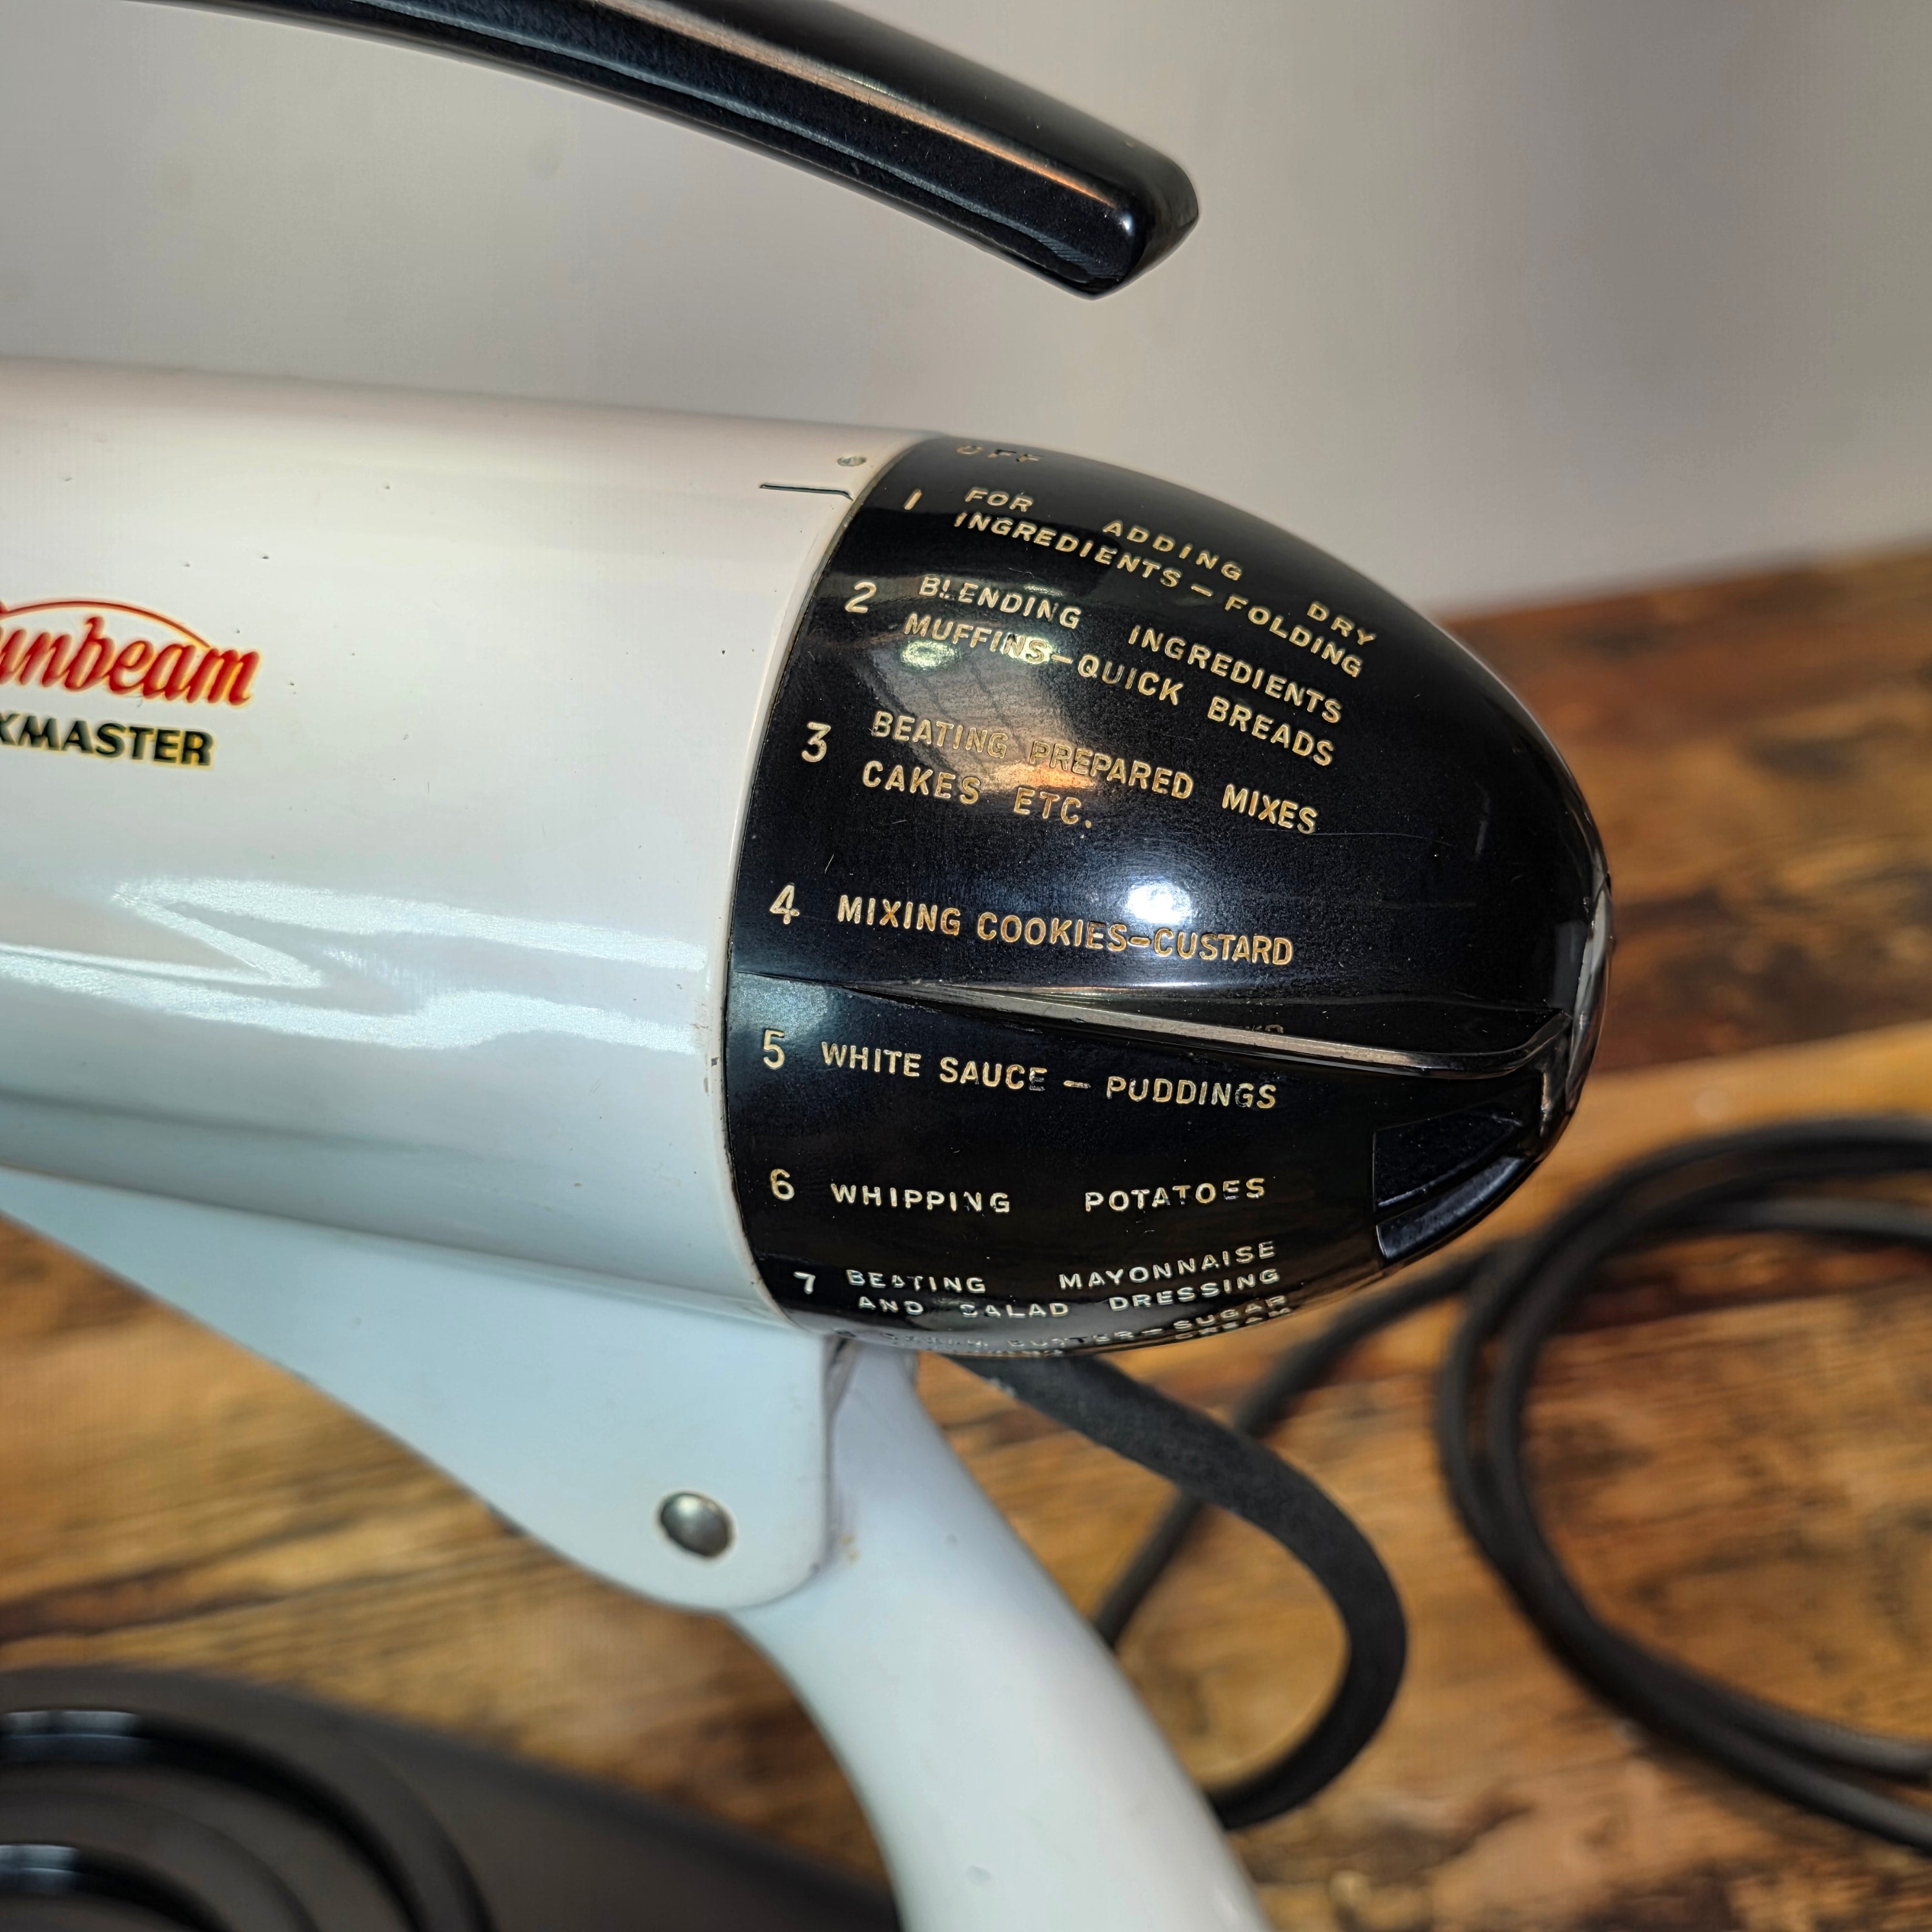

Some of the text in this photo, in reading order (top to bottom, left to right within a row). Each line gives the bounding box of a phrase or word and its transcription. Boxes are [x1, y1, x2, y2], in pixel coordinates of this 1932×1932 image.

[904, 486, 1377, 646] 1 FOR ADDING DRY
[953, 511, 1180, 590] INGREDIENTS
[1222, 595, 1364, 679] FOLDING
[844, 575, 1344, 724] 2 BLENDING INGREDIENTS
[1208, 695, 1335, 768] BREADS
[801, 710, 1319, 835] 3 BEATING PREPARED MIXES
[863, 760, 1093, 830] CAKES ETC.
[769, 883, 800, 926] 4
[837, 895, 961, 937] MIXING
[762, 1029, 786, 1069] 5
[821, 1041, 922, 1078] WHITE
[939, 1056, 1049, 1093] SAUCE
[1105, 1075, 1277, 1111] PUDDINGS
[770, 1168, 1266, 1214] 6 WHIPPING POTATOES
[794, 1241, 1277, 1295] 7 BEATING MAYONNAISE
[858, 1268, 1281, 1319] AND SALAD DRESSING
